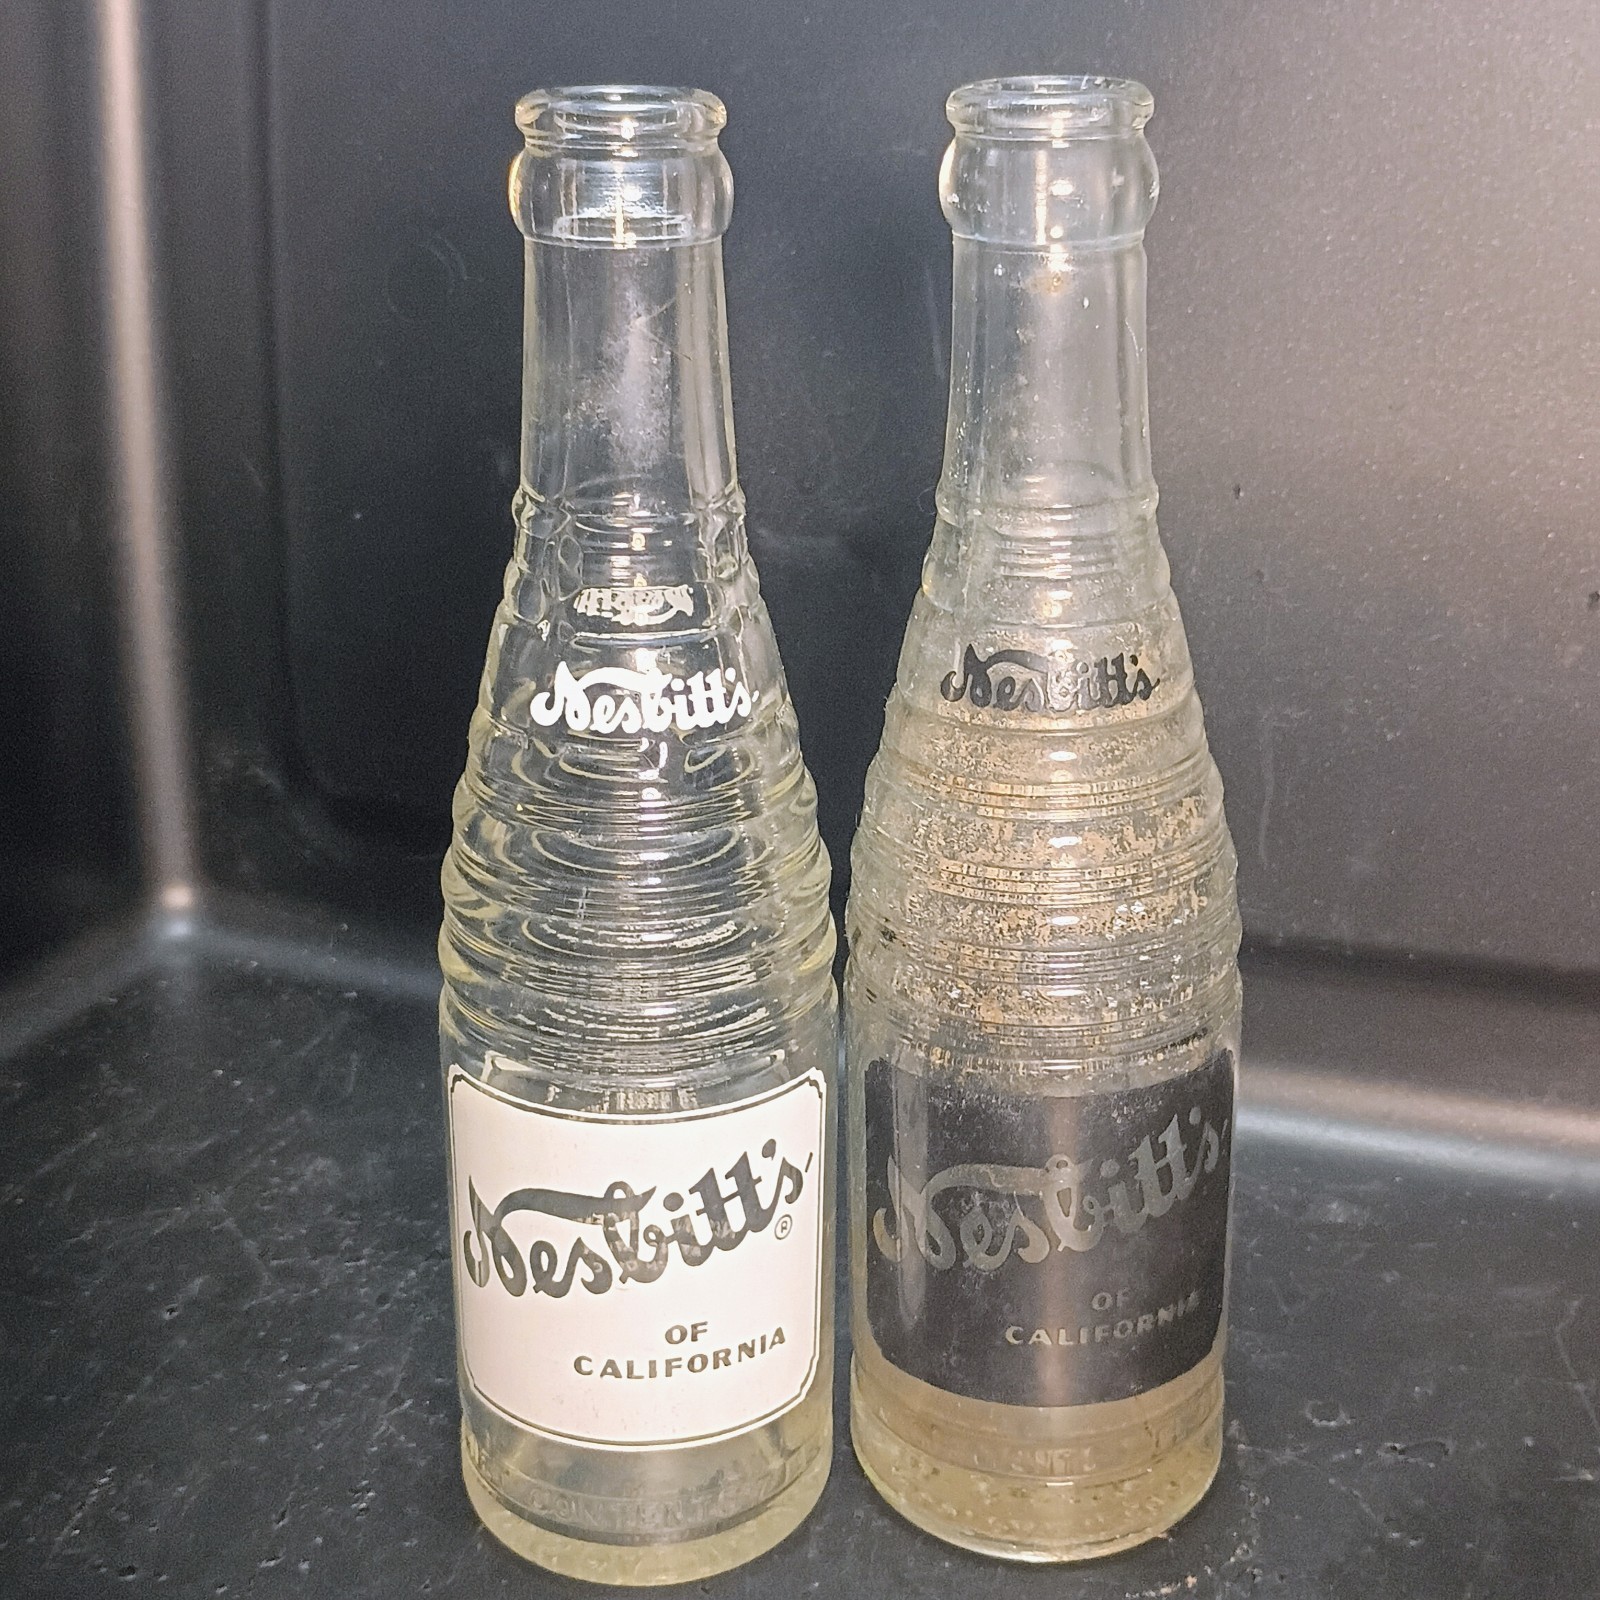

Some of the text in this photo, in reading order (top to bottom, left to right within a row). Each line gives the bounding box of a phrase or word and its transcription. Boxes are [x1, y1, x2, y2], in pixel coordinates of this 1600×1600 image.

[529, 660, 760, 734] Nesbitt's
[940, 643, 1161, 713] Nesbitt's
[463, 1138, 814, 1298] Nesbitt's
[872, 1106, 1229, 1271] Nesbitt's
[664, 1320, 709, 1345] OF
[1091, 1287, 1132, 1312] OF
[573, 1325, 787, 1380] CALIFORNIA
